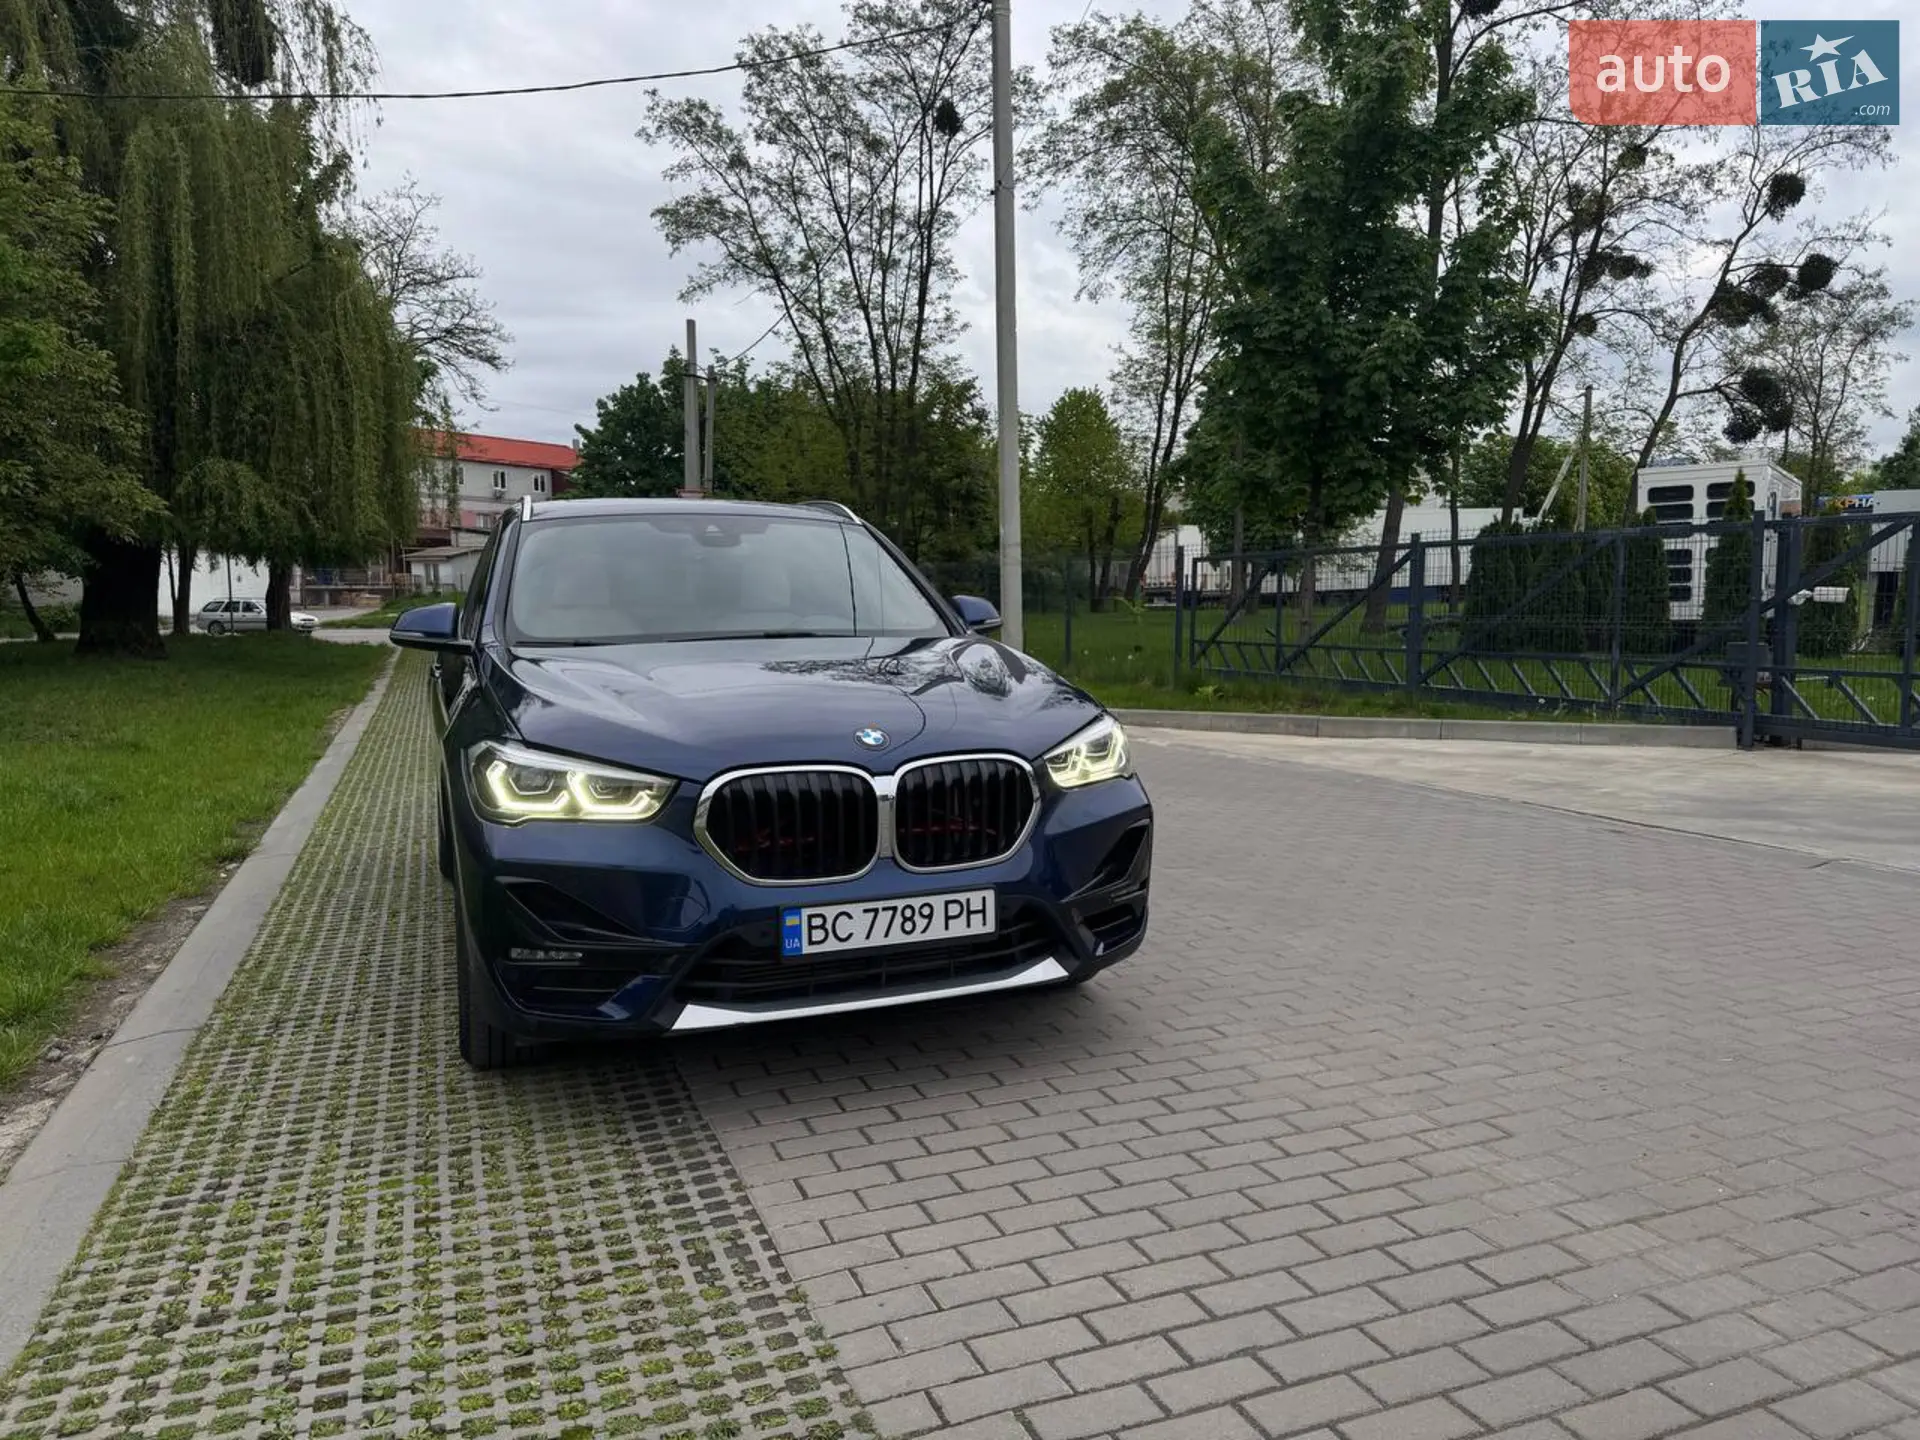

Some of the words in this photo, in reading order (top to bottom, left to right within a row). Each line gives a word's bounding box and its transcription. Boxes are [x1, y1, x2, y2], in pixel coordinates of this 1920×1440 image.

[807, 911, 853, 946] BC
[862, 902, 934, 939] 7789
[944, 896, 987, 931] PH
[785, 939, 799, 948] UA
